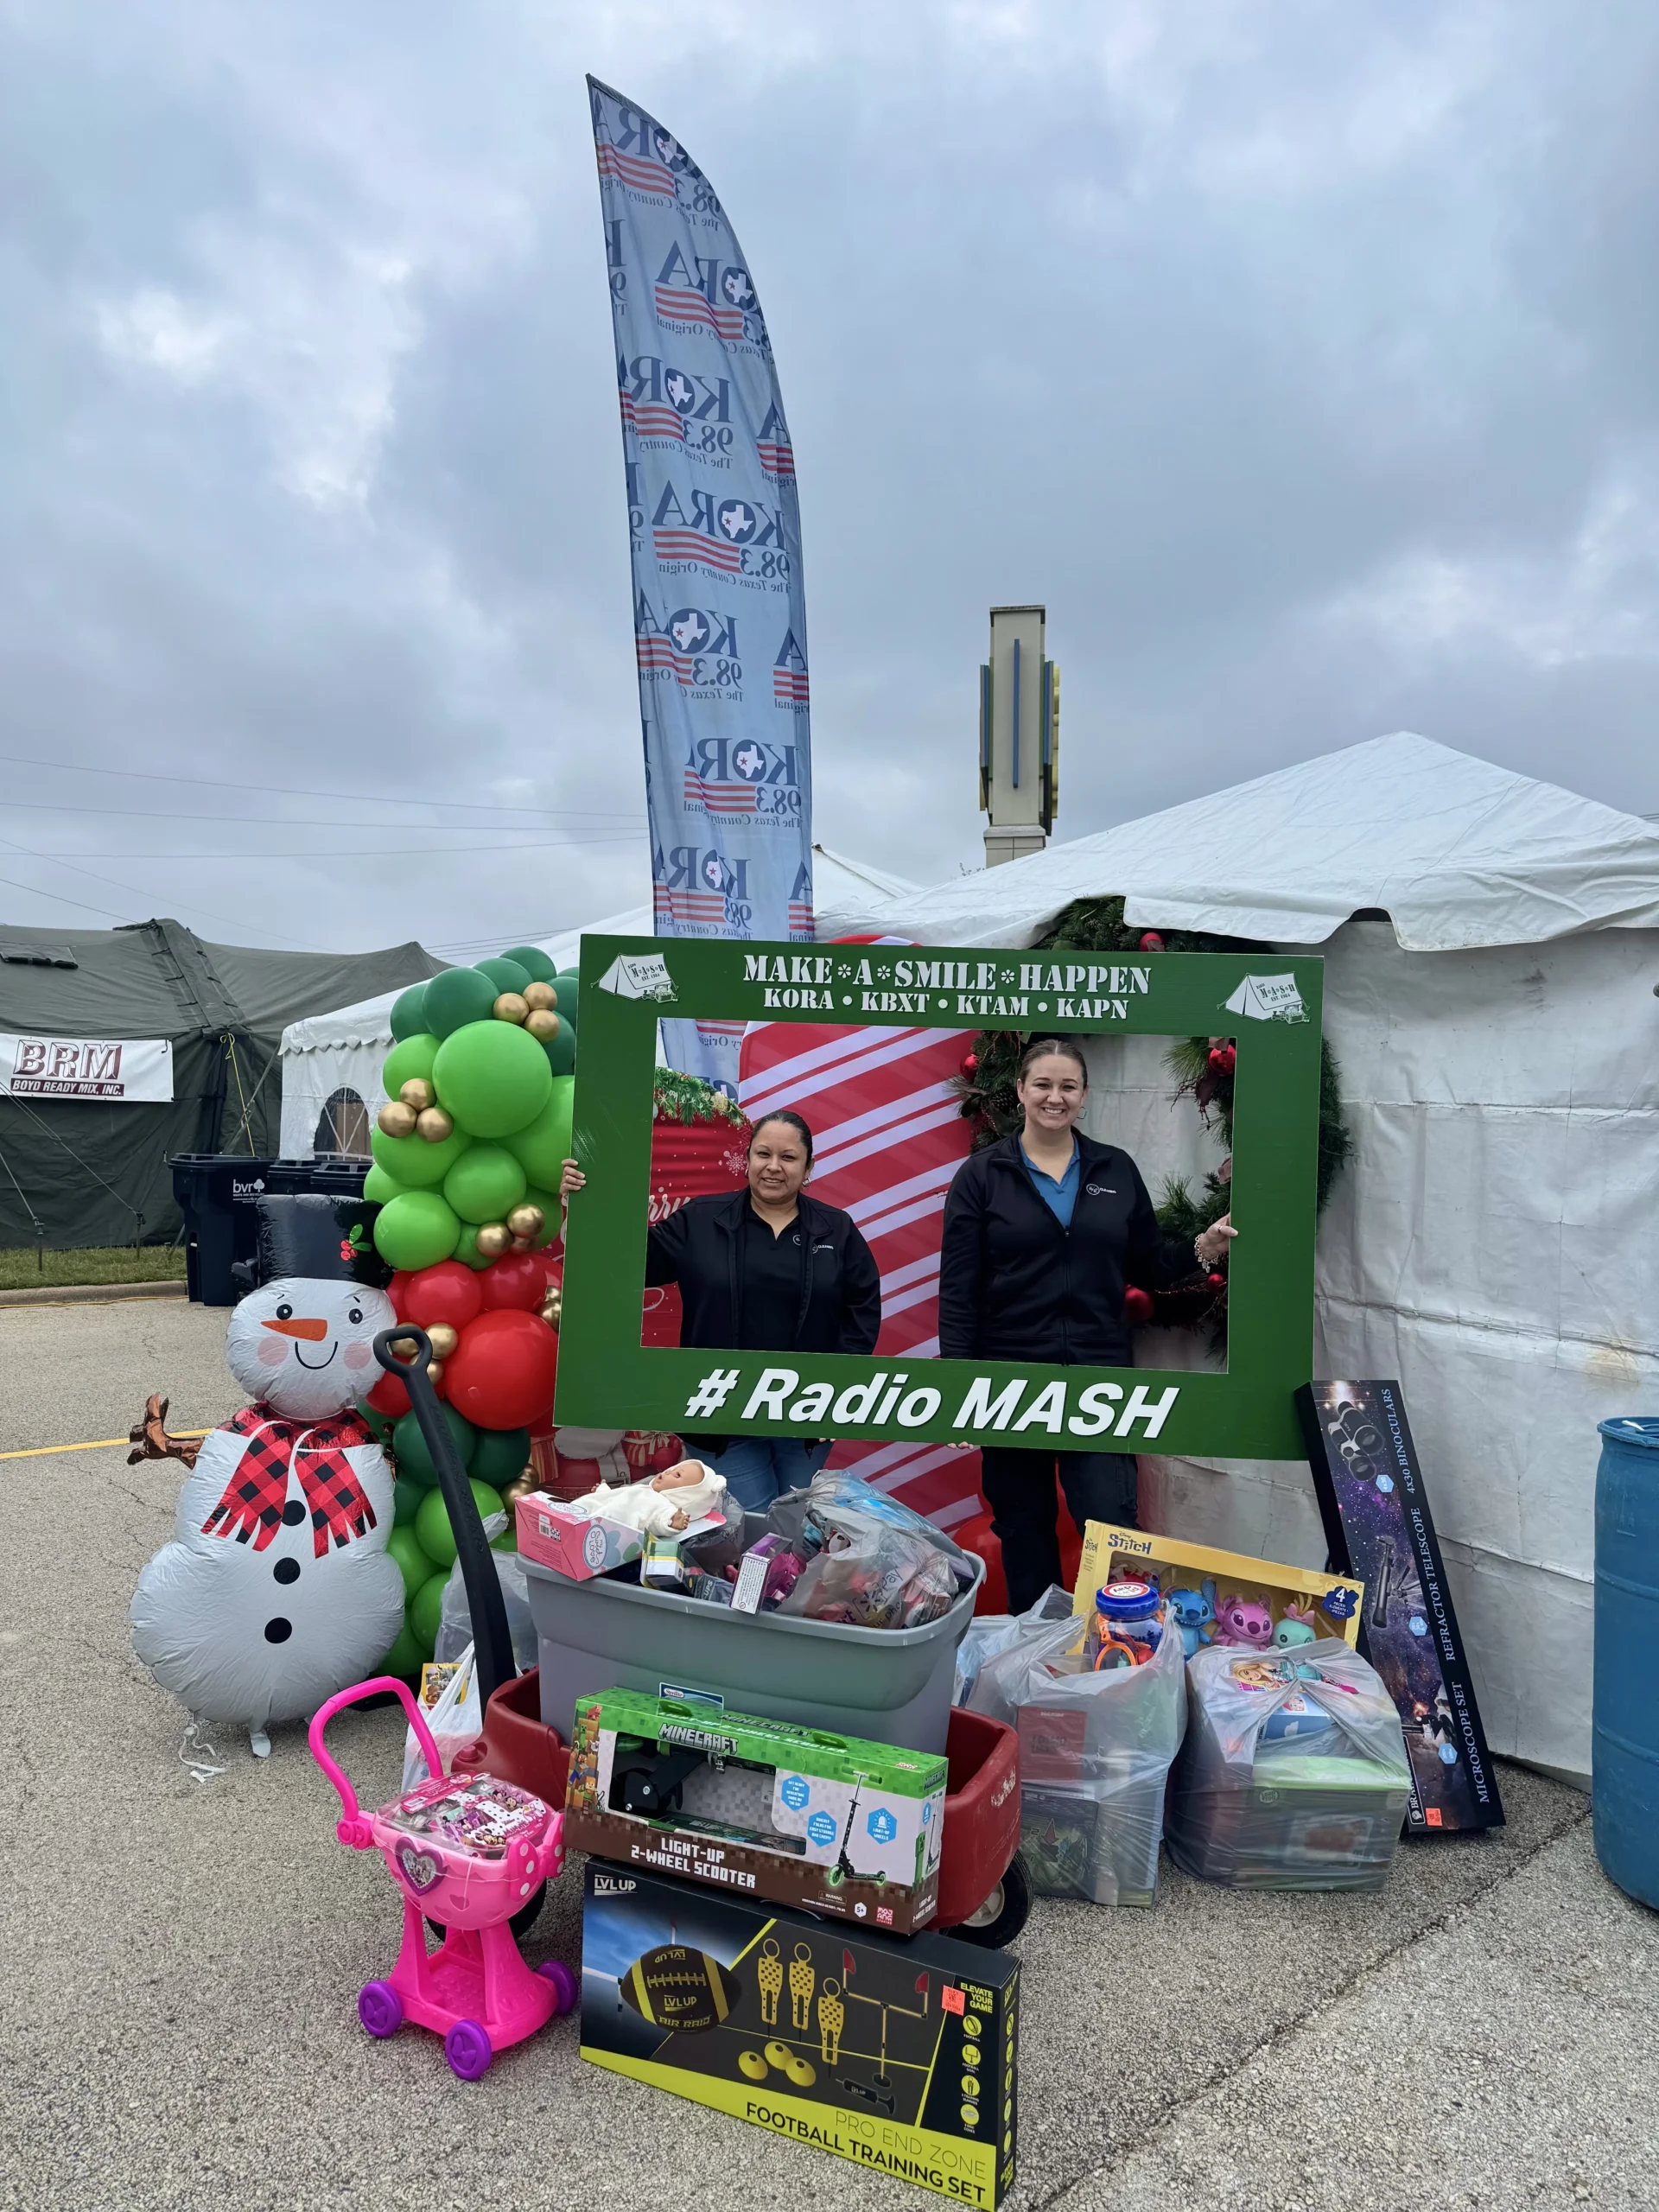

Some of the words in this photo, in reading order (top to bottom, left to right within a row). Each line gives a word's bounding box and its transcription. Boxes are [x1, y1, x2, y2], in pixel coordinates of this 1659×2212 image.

[743, 955, 833, 984] MAKE
[852, 958, 874, 986] A
[894, 960, 996, 990] SMILE
[1019, 963, 1152, 995] HAPPEN
[763, 988, 835, 1010] KORA
[861, 991, 931, 1013] KBXT
[957, 995, 1030, 1016] KTAM
[1056, 998, 1129, 1020] KAPN
[13, 1039, 123, 1080] BRM
[12, 1079, 41, 1092] BOYD
[42, 1081, 77, 1093] READY
[78, 1084, 99, 1096] MIX,
[101, 1084, 121, 1096] INC.
[233, 1179, 253, 1192] bvr
[683, 1369, 738, 1418] #
[741, 1368, 943, 1427] Radio
[951, 1376, 1181, 1439] MASH
[1381, 1389, 1409, 1466] BINOCULARS
[1410, 1507, 1435, 1580] TELESCOPE
[1335, 1588, 1345, 1603] 4
[1428, 1581, 1456, 1661] REFRACTOR
[1452, 1681, 1466, 1707] SET
[718, 1713, 812, 1737] MINECRAFT
[658, 1723, 739, 1755] MINECRAFT
[1458, 1708, 1490, 1803] MICROSCOPE
[661, 1837, 725, 1864] LIGHT-UP
[631, 1845, 690, 1872] 2-WHEEL
[694, 1861, 756, 1889] SCOOTER
[594, 1877, 618, 1891] LVL
[618, 1878, 637, 1891] UP
[664, 1996, 682, 2007] LVL
[683, 1996, 697, 2006] UP
[960, 1982, 993, 1999] ELEVATE
[971, 1993, 993, 2005] YOUR
[969, 2000, 993, 2014] GAME
[658, 2015, 680, 2028] AIR
[963, 2033, 981, 2043] FOOTBALL
[962, 2063, 979, 2071] FOOTBALL
[747, 2101, 845, 2152] FOOTBALL
[849, 2139, 944, 2188] TRAINING
[948, 2176, 986, 2202] SET
[836, 2111, 875, 2138] PRO
[882, 2127, 923, 2155] END
[930, 2144, 986, 2180] ZONE
